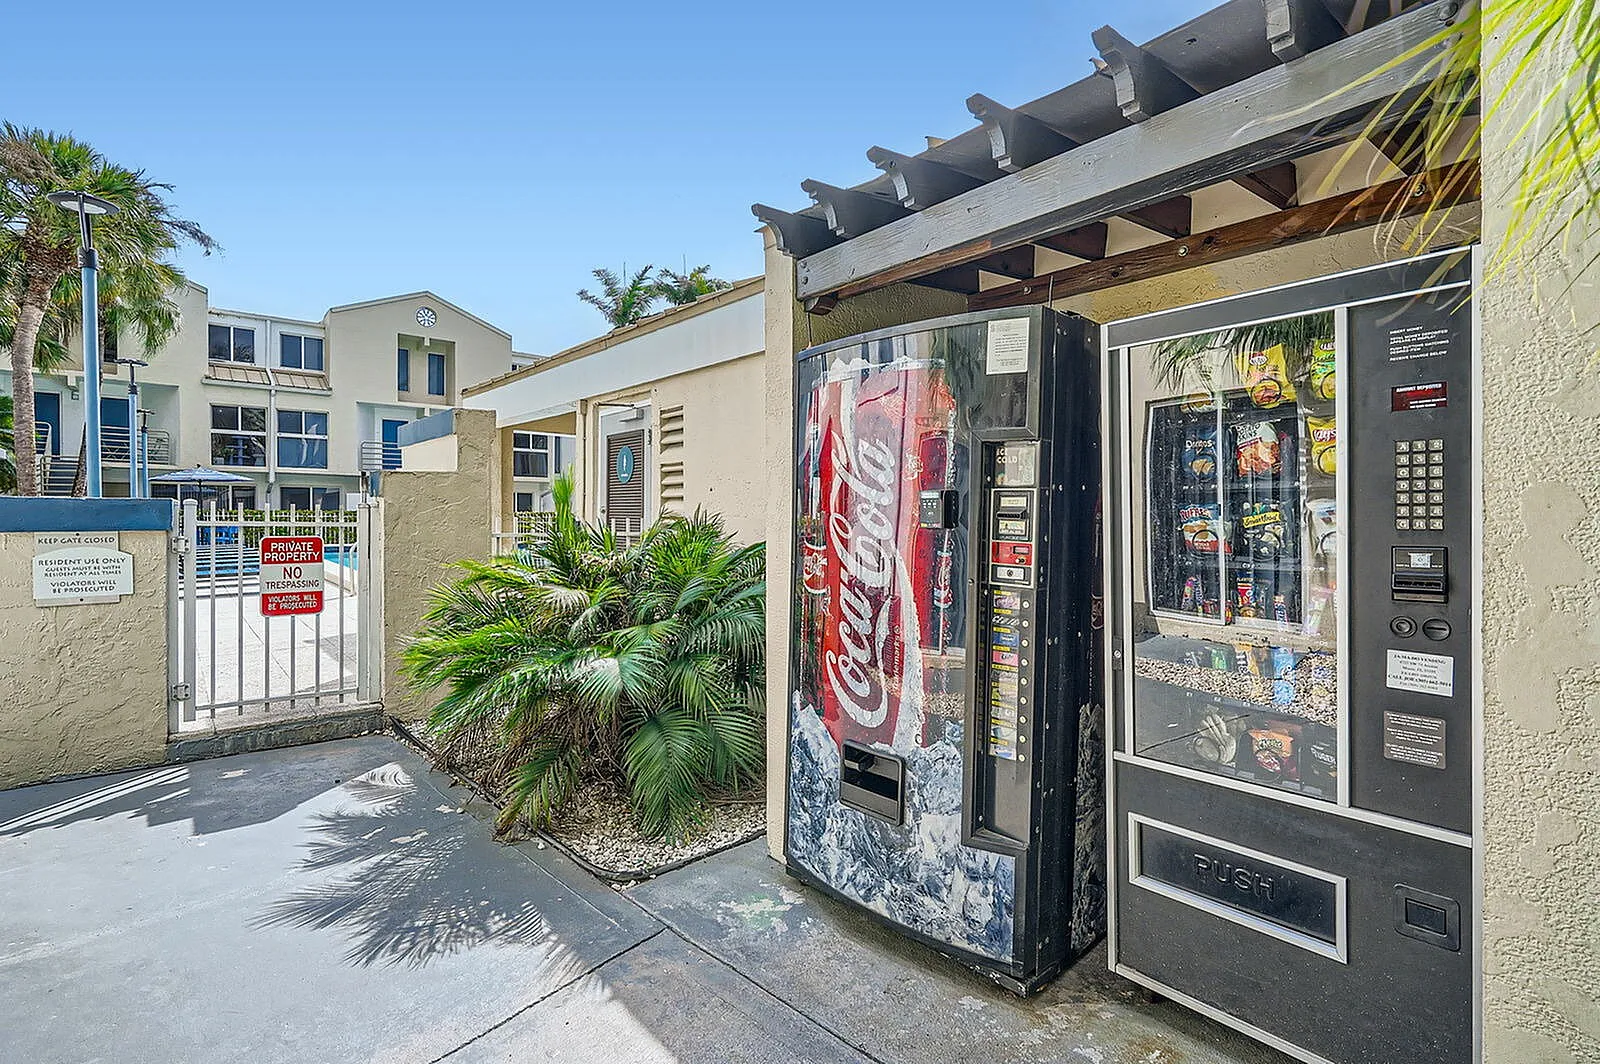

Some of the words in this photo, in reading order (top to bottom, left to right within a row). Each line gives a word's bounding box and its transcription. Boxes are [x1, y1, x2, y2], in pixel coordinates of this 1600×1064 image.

[1185, 439, 1213, 448] Doritos
[271, 542, 314, 552] PRIVATE
[264, 552, 320, 562] PROPERTY
[283, 566, 302, 579] NO
[265, 580, 319, 589] TRESPASSING
[826, 431, 896, 729] Coca-Cola
[280, 601, 318, 610] PROSECUTED
[1194, 854, 1275, 902] PUSH
